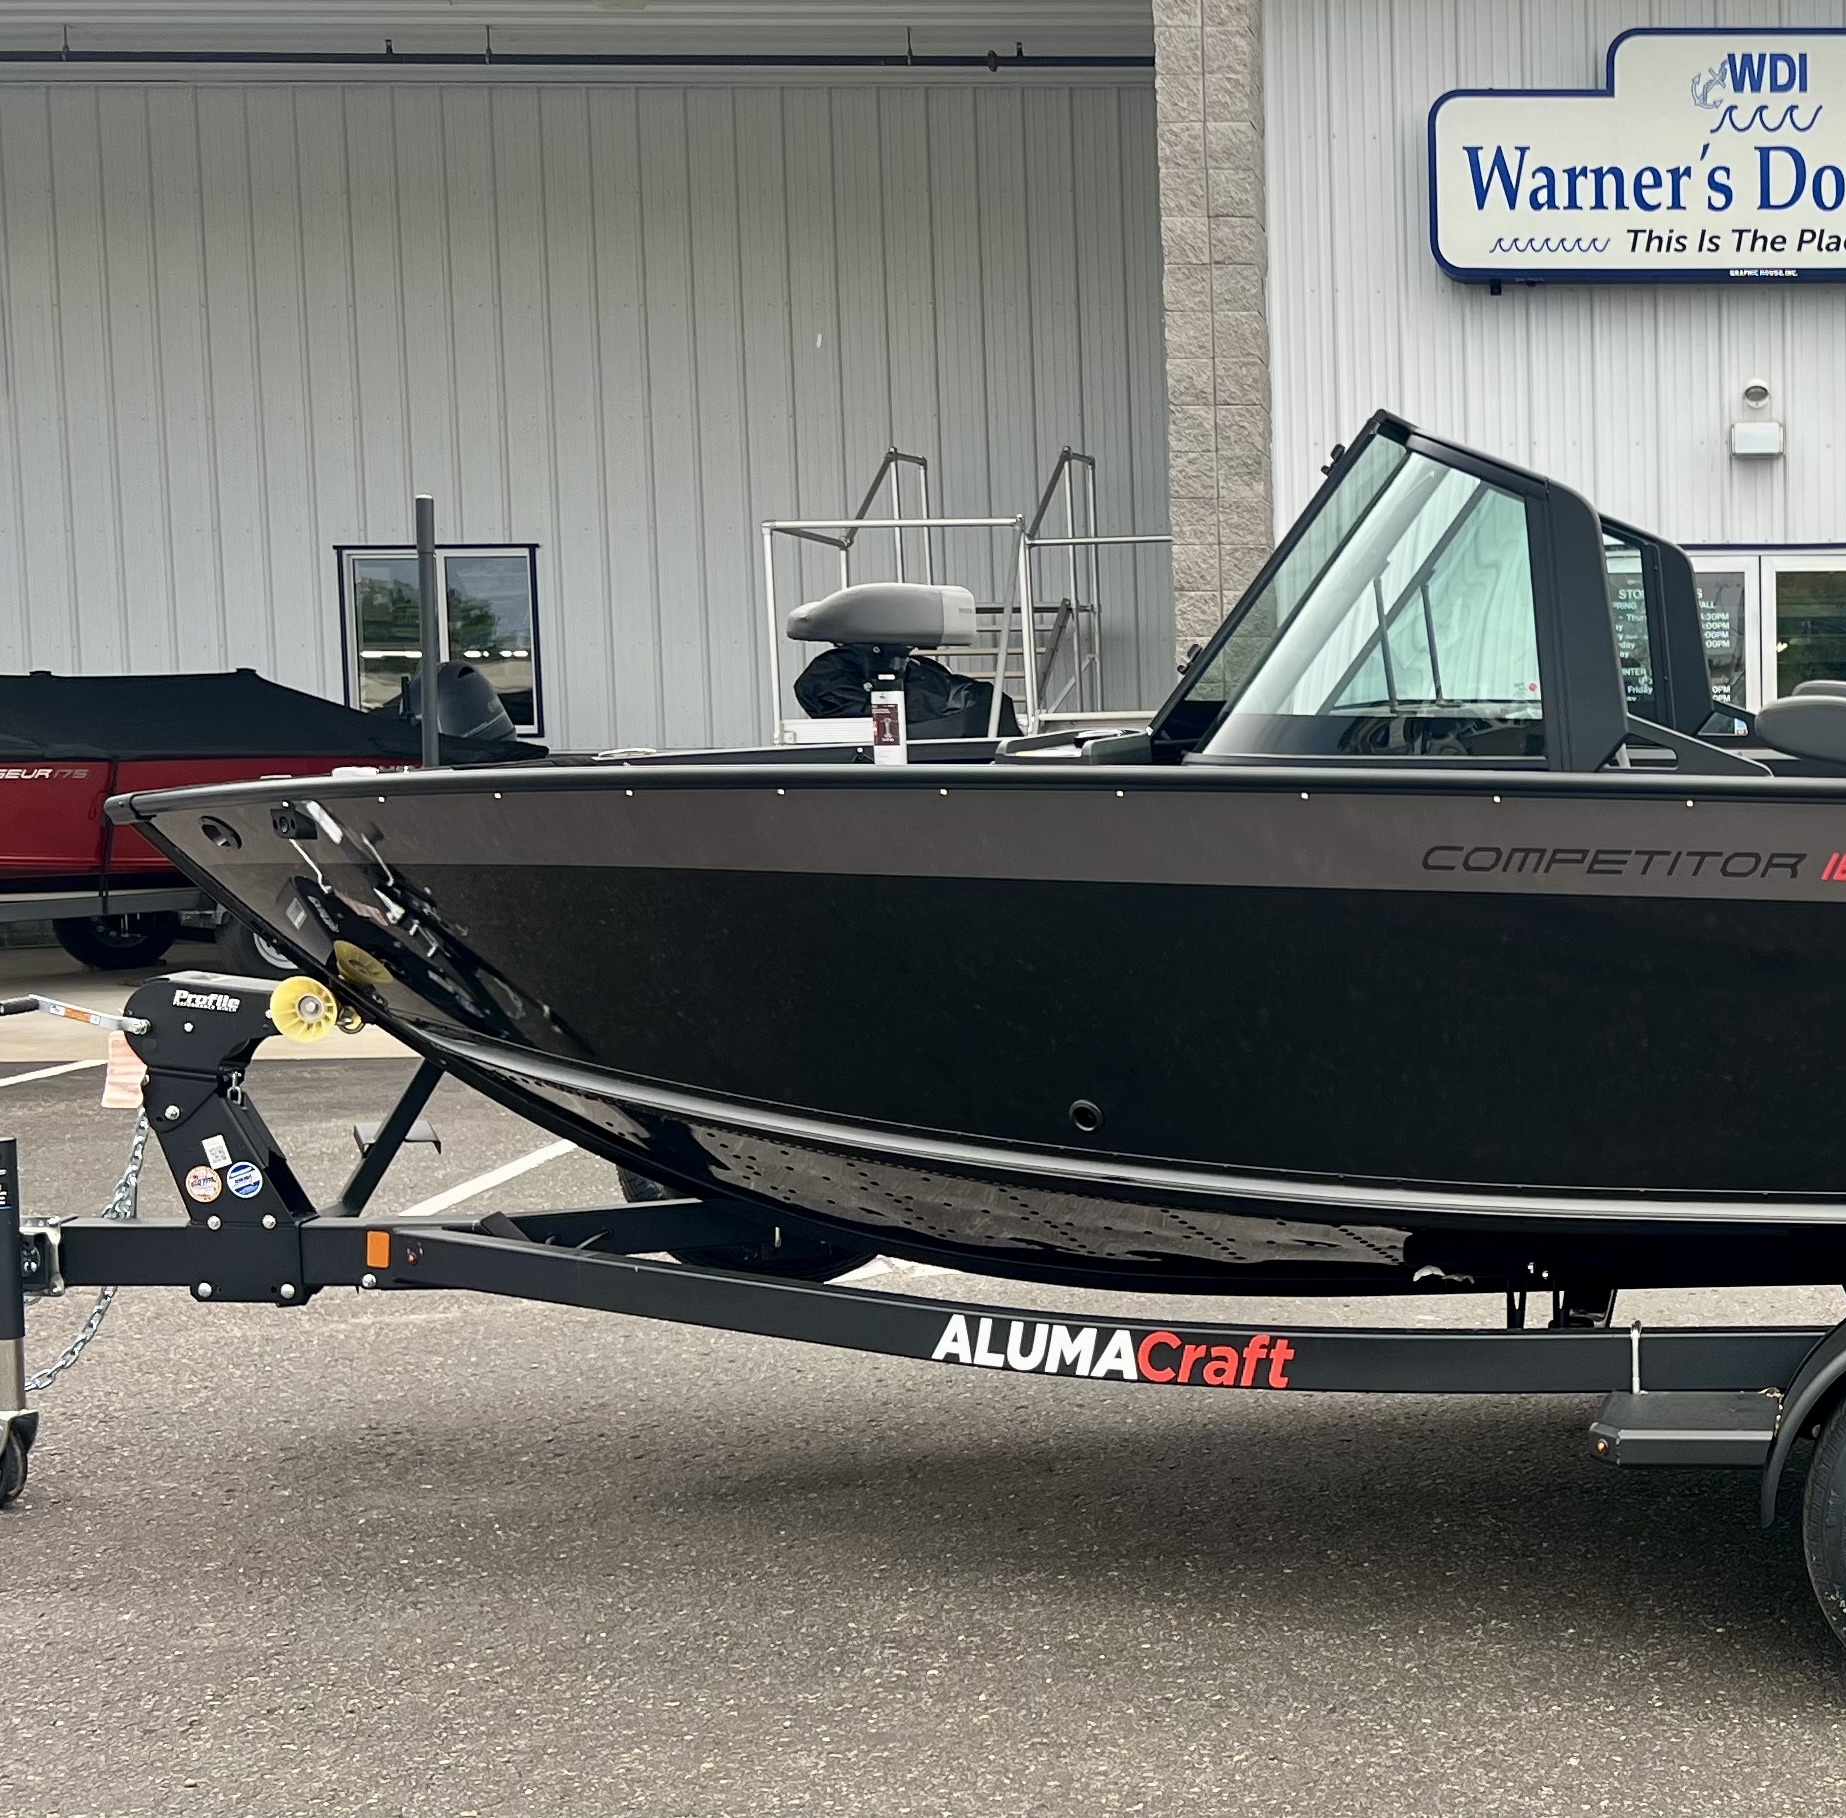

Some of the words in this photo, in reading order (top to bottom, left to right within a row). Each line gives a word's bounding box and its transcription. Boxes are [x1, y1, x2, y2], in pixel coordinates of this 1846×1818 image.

[1726, 53, 1807, 93] WDI
[1463, 142, 1733, 211] Warner's
[1626, 229, 1688, 254] This
[1697, 229, 1721, 254] Is
[1732, 229, 1788, 254] The
[53, 768, 90, 779] 175
[1422, 845, 1806, 880] COMPETITOR
[173, 989, 241, 1009] Profile
[931, 1313, 1295, 1389] ALUMACraft
